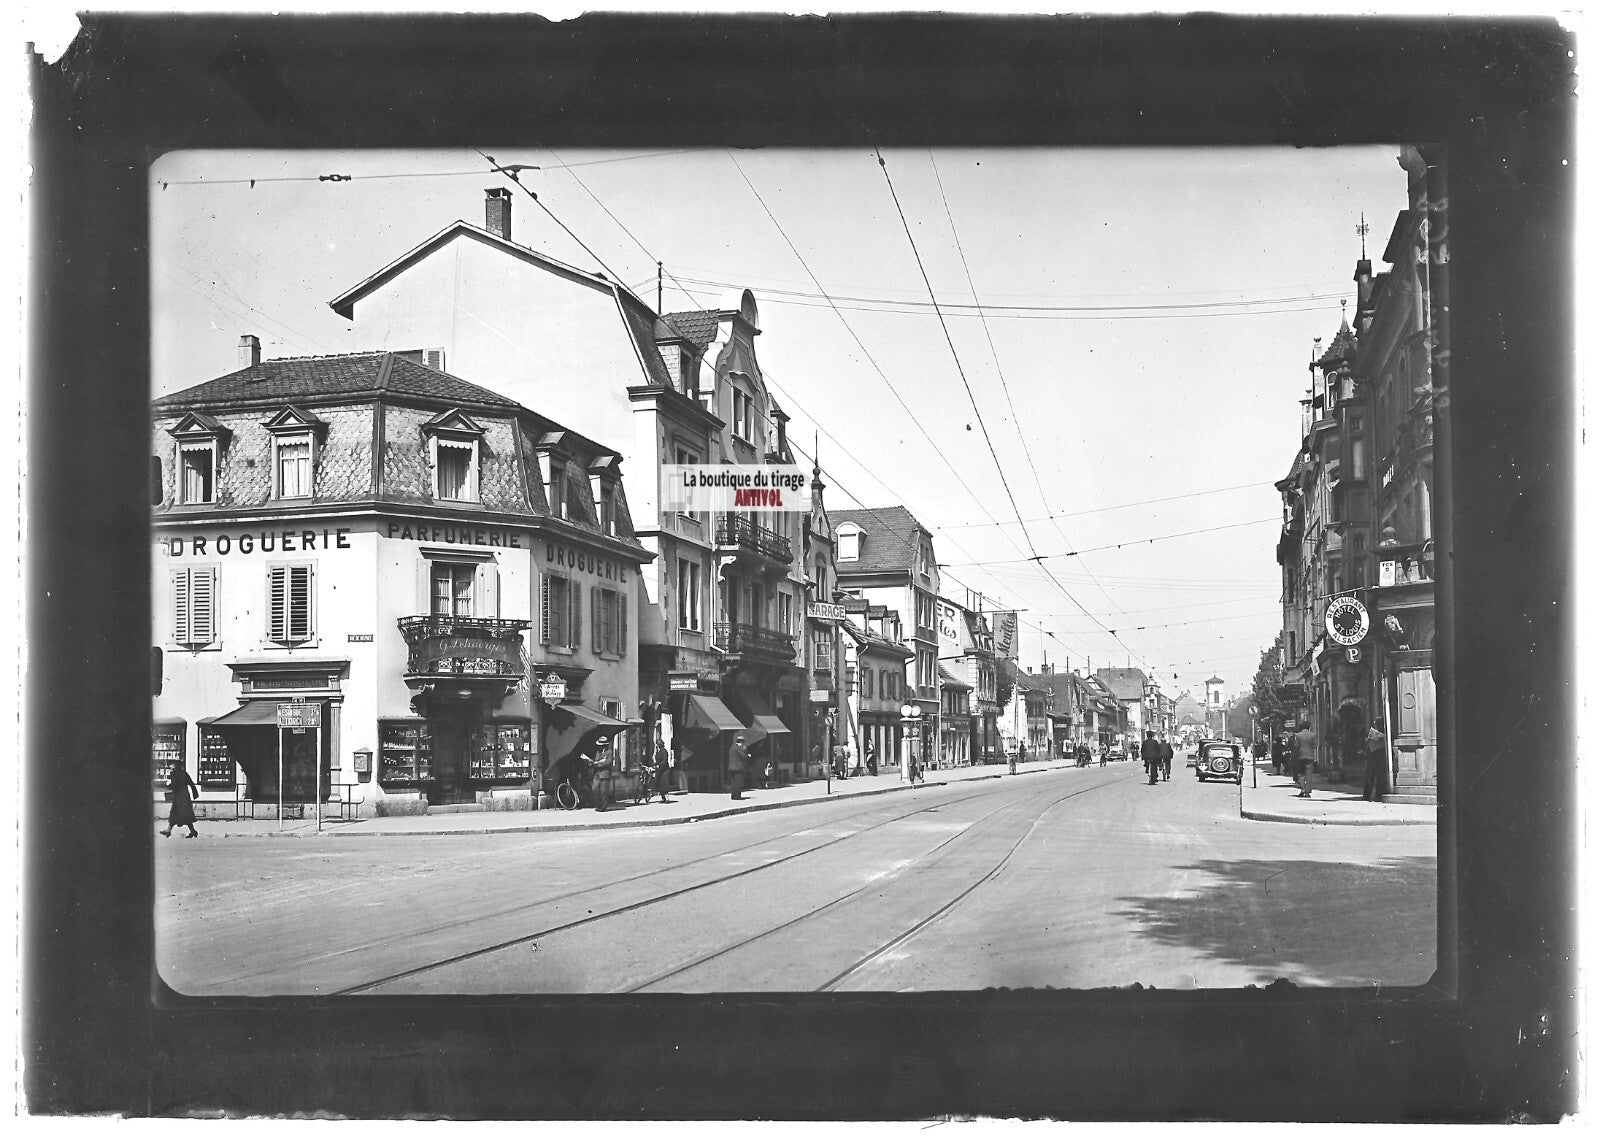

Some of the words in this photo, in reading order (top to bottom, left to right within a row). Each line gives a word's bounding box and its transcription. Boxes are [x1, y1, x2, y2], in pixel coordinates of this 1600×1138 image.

[170, 528, 351, 556] DROGUERIE
[388, 523, 521, 548] PARFUMERIE
[547, 544, 628, 583] DROGUERIE
[1327, 598, 1366, 618] RESTAURANT
[1332, 627, 1367, 644] ALSACIEN
[1346, 619, 1361, 636] LOUIS
[1348, 648, 1359, 662] P
